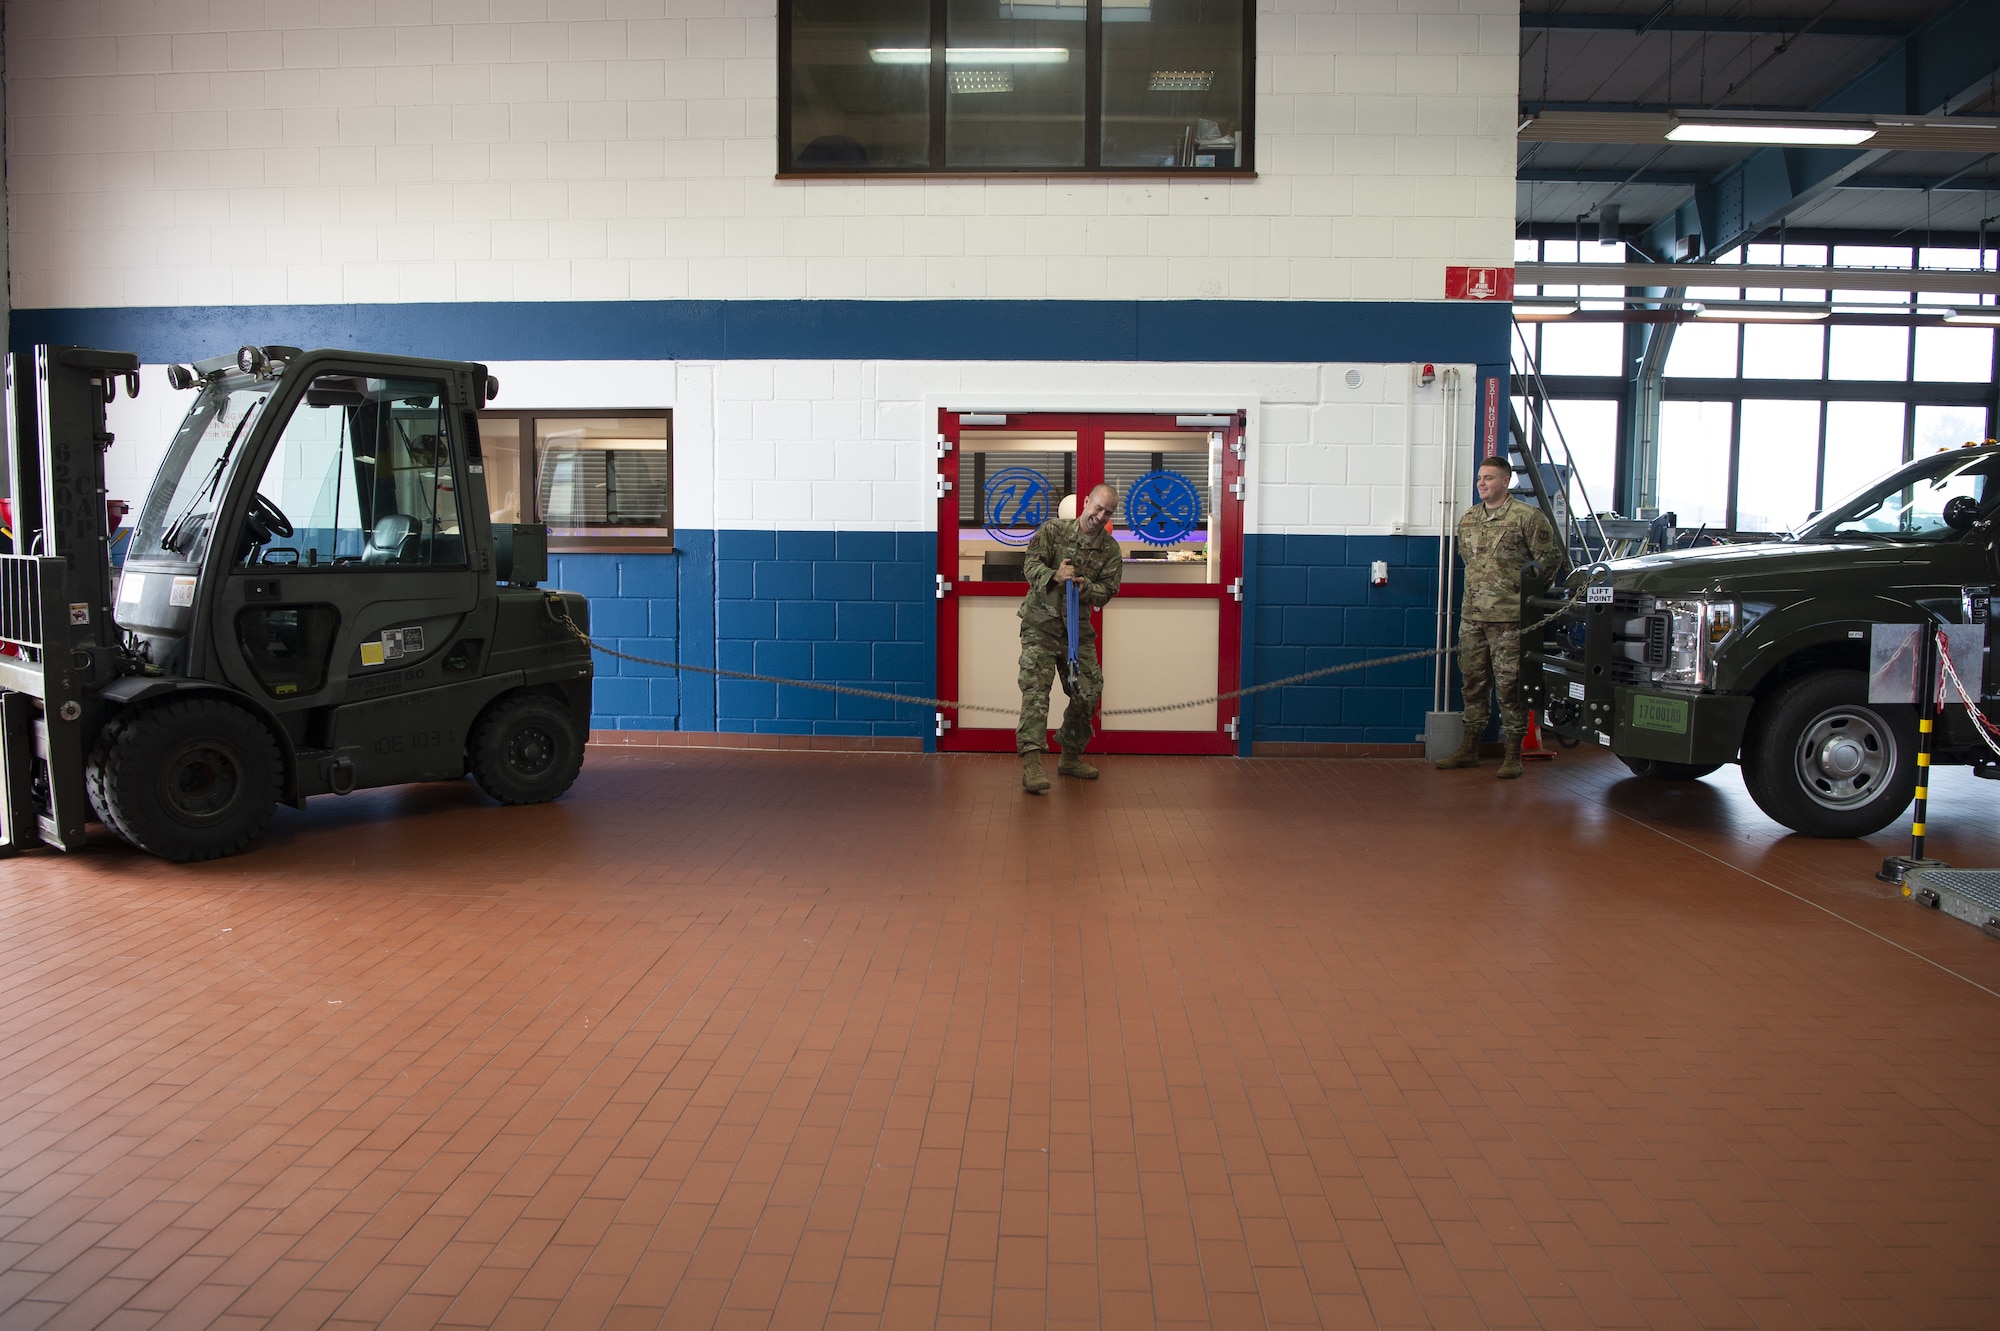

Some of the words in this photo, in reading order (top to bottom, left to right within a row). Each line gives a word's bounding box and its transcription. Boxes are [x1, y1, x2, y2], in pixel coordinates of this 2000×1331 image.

[1487, 378, 1496, 457] EXTINGUISHE
[75, 475, 94, 539] CAP
[405, 668, 425, 681] 60
[1639, 704, 1681, 723] 17C00189
